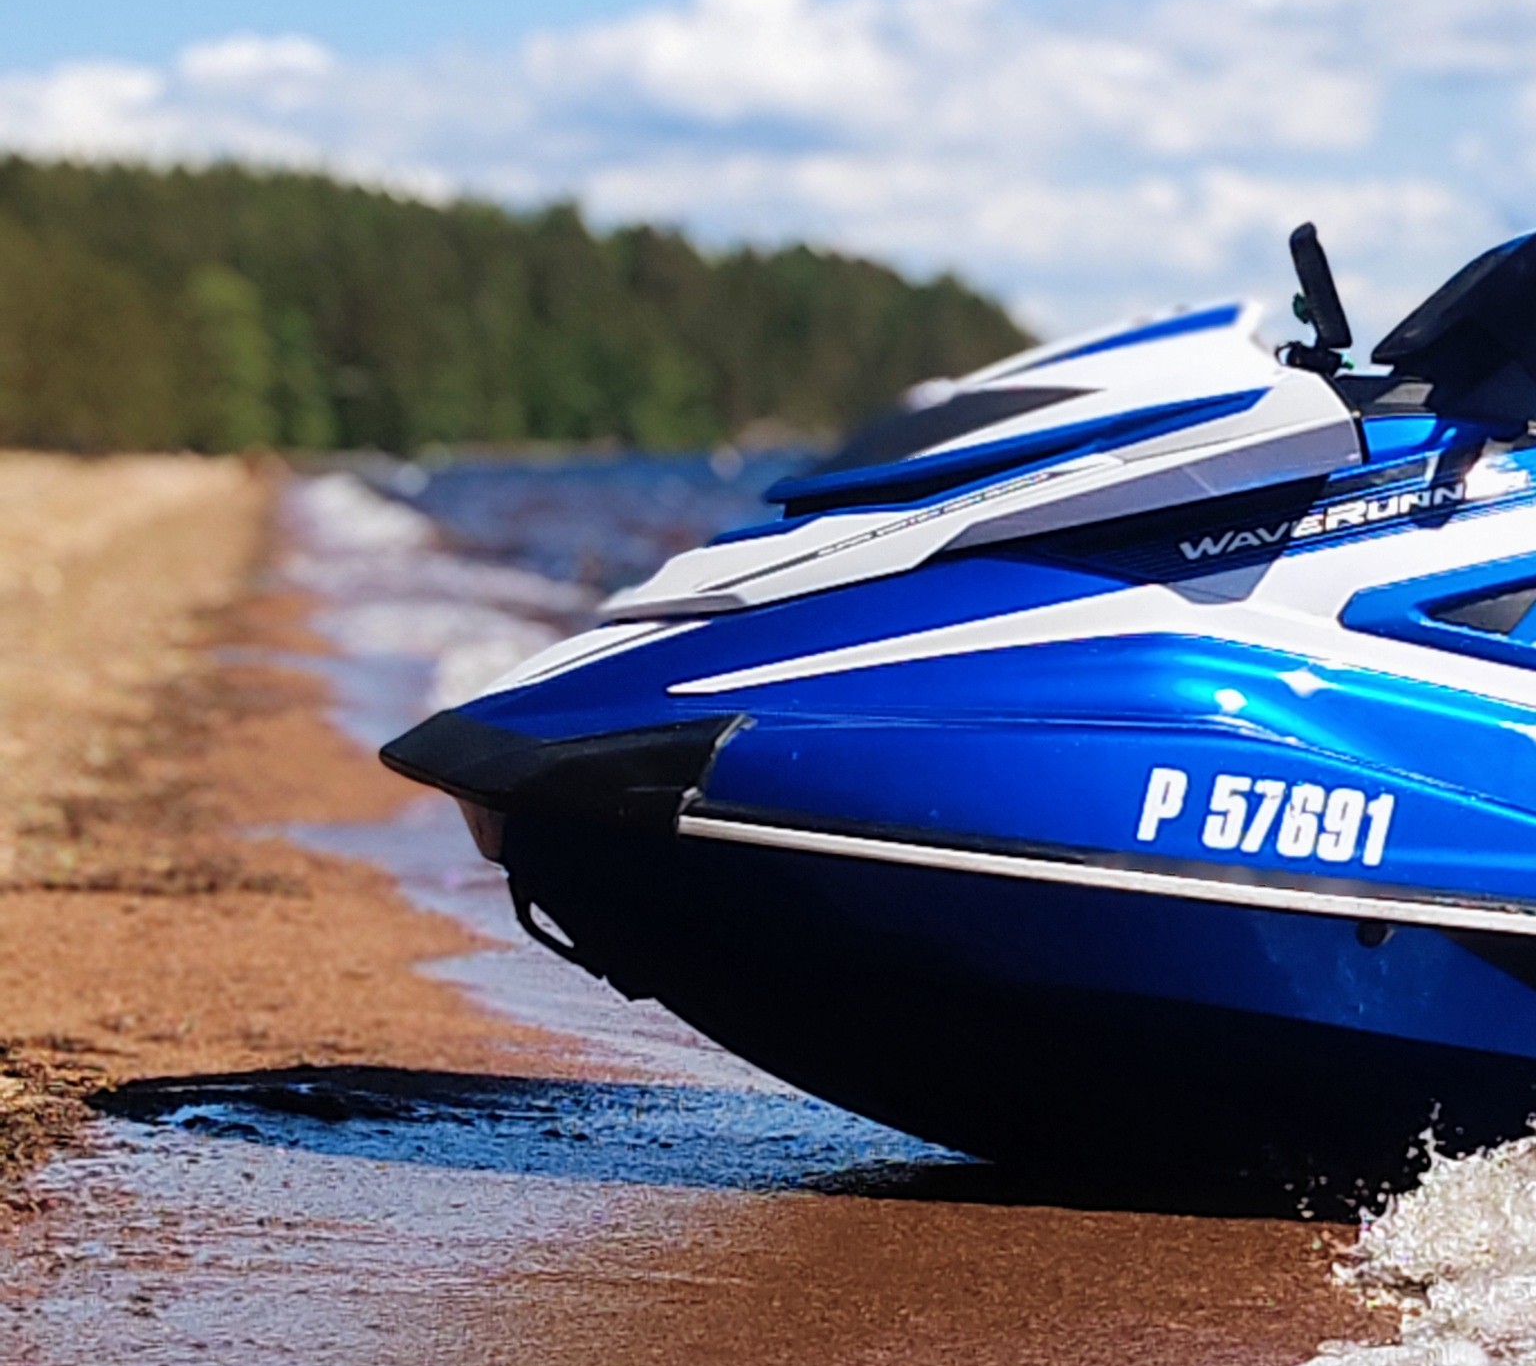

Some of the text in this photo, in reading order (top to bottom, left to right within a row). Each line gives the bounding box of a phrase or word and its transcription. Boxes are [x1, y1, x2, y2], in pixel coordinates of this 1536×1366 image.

[1179, 473, 1527, 561] WAVERUNN
[1137, 767, 1394, 866] P 57691
